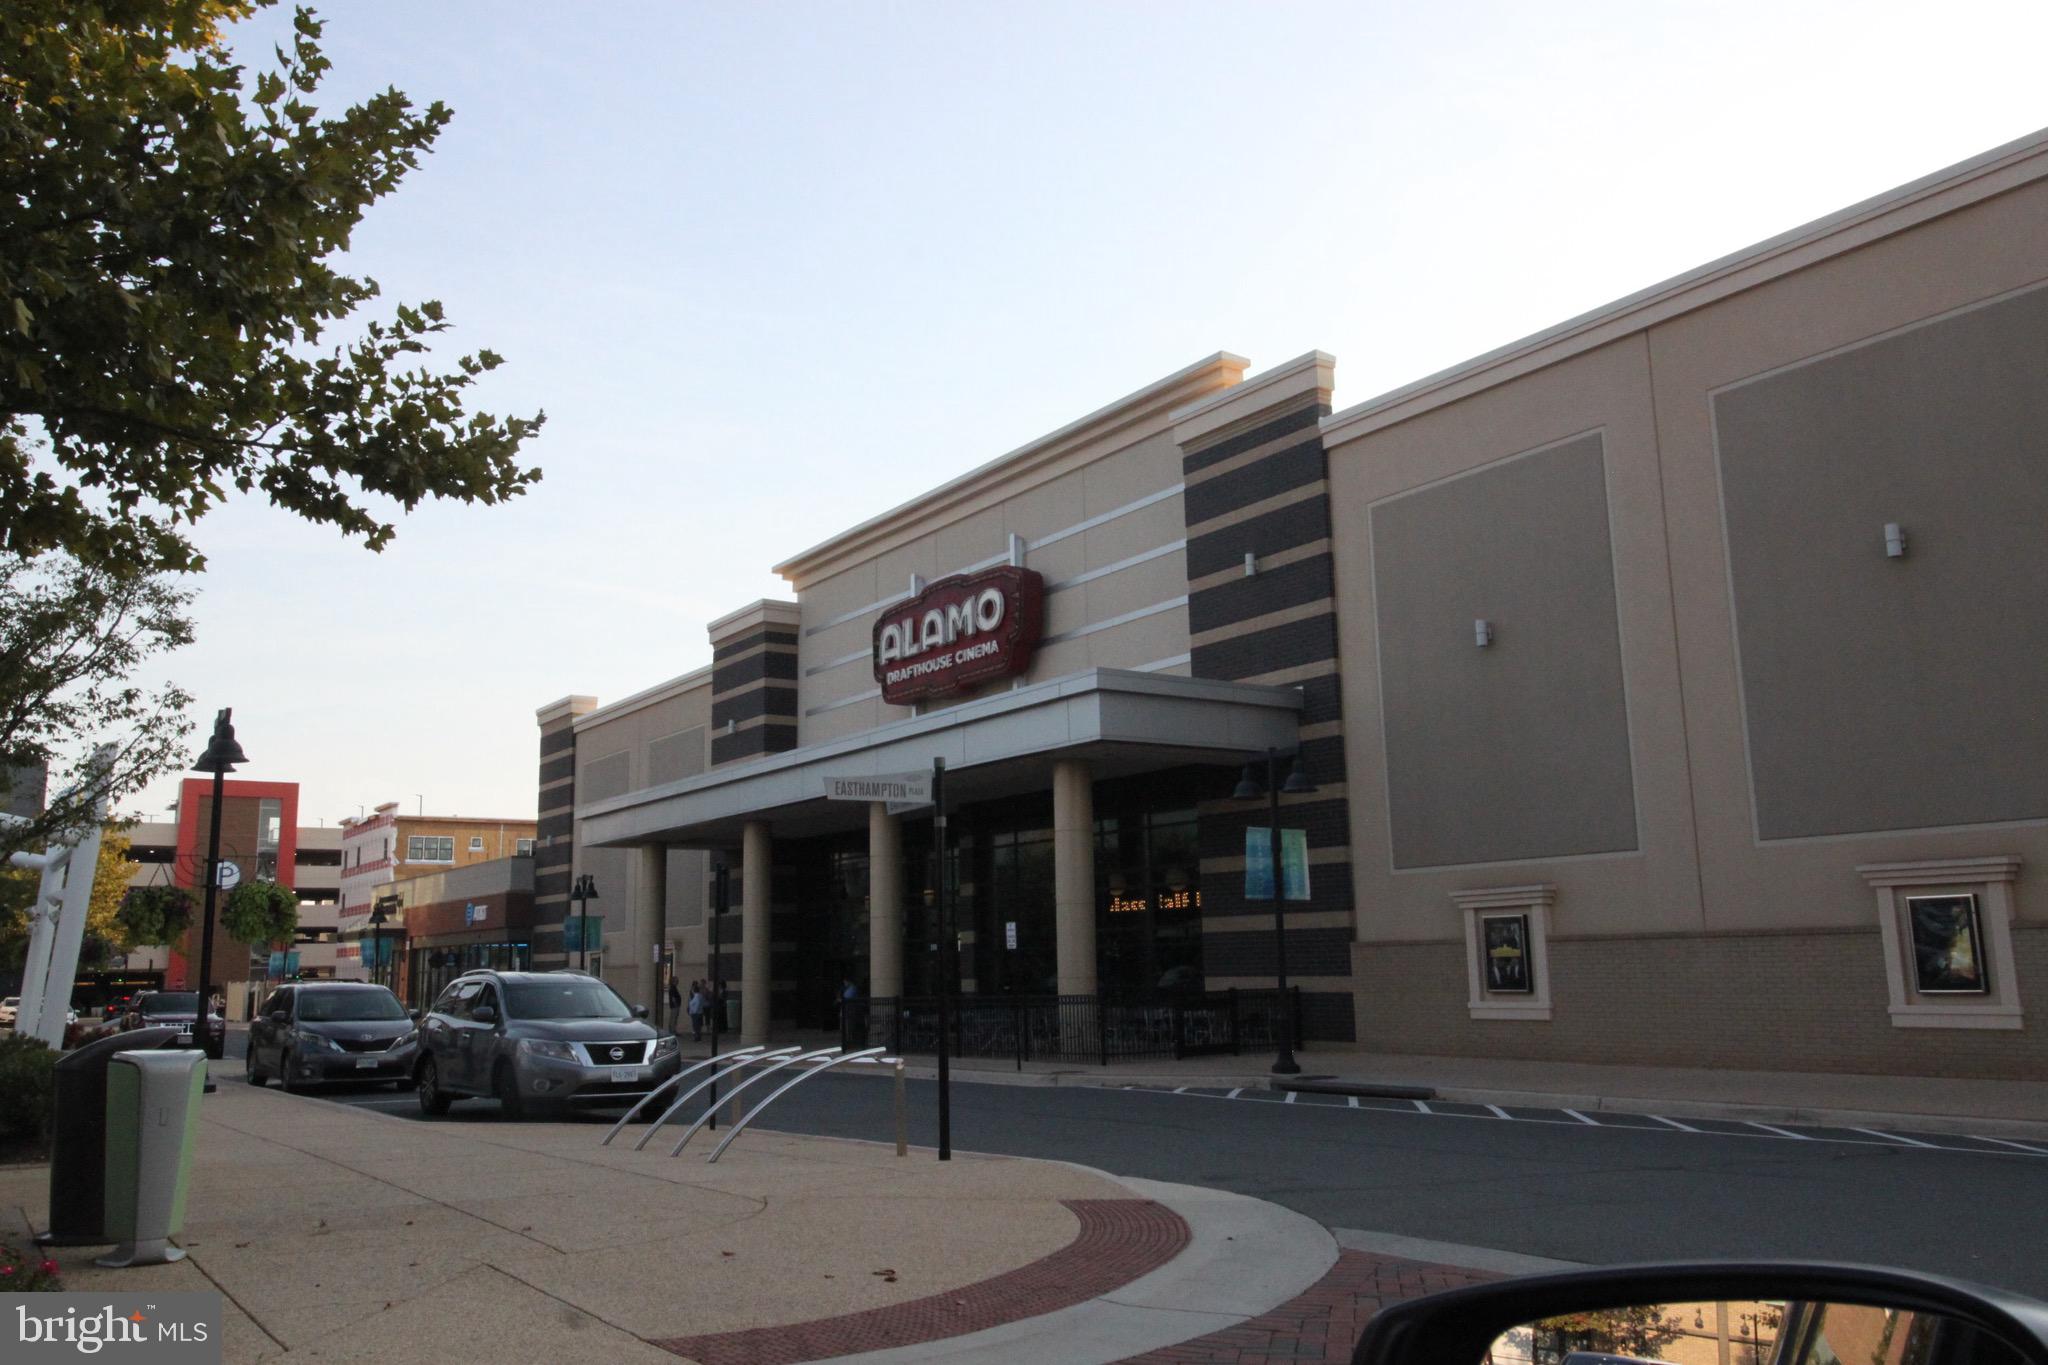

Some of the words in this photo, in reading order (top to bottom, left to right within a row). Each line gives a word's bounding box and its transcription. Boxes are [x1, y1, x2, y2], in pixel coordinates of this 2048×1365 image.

[879, 588, 1005, 665] ALAMO
[886, 653, 953, 685] DRAFTHOUSE
[955, 640, 999, 665] CINEMA
[834, 780, 907, 798] EASTHAMPTON
